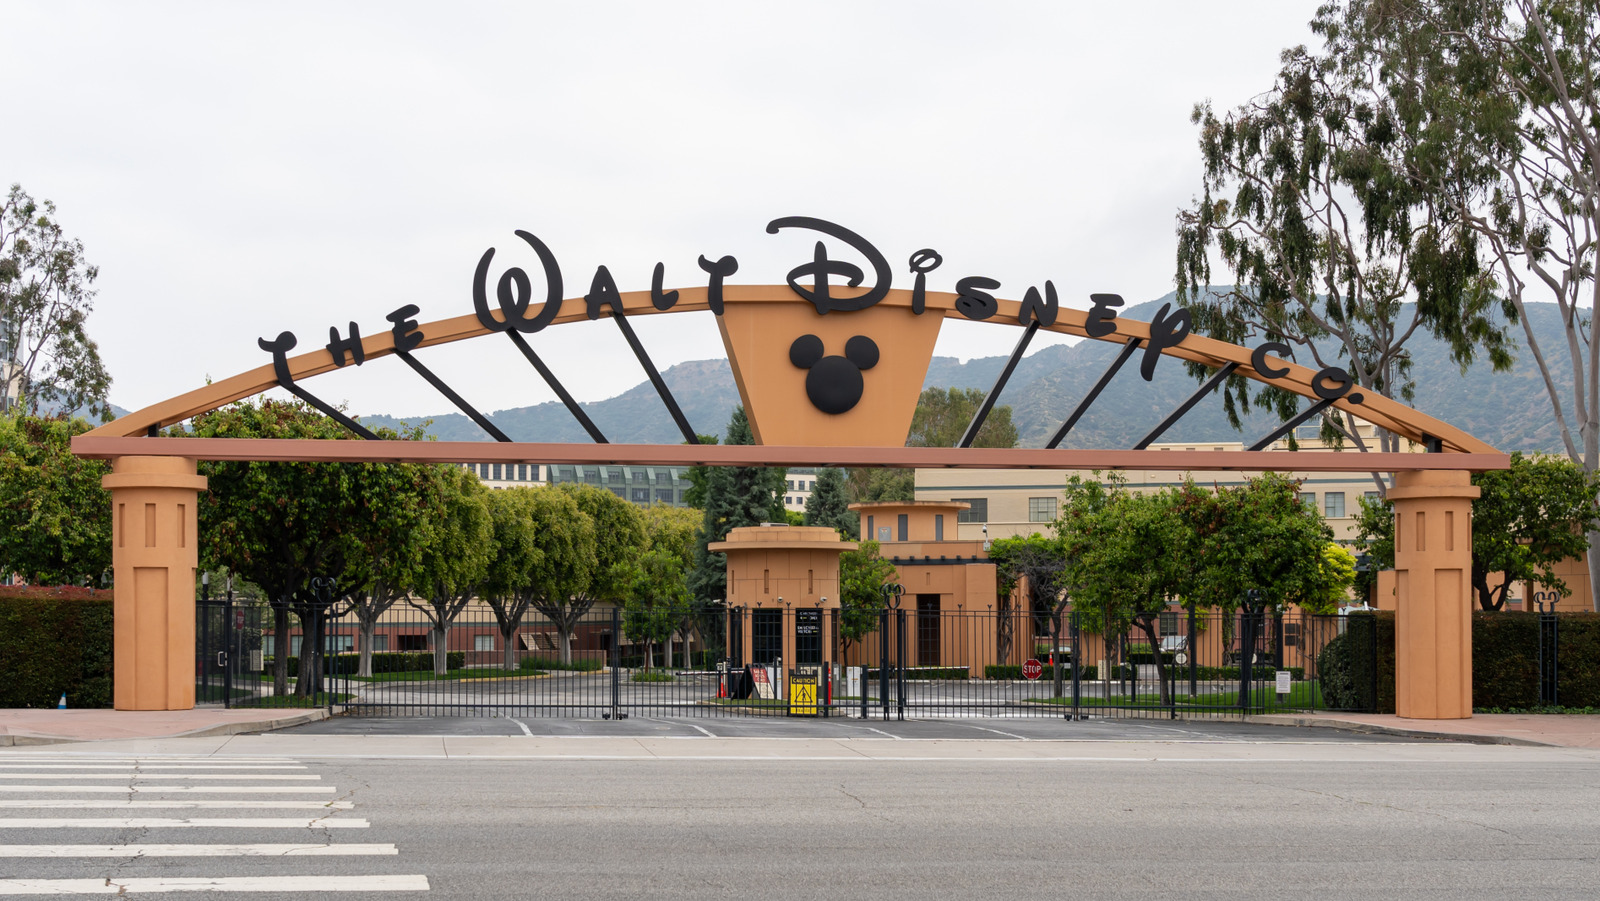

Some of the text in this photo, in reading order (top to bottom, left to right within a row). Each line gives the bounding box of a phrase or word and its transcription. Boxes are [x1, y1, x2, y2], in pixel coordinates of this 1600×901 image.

[258, 304, 424, 387] THE
[473, 229, 739, 333] WALT
[1023, 665, 1042, 673] STOP
